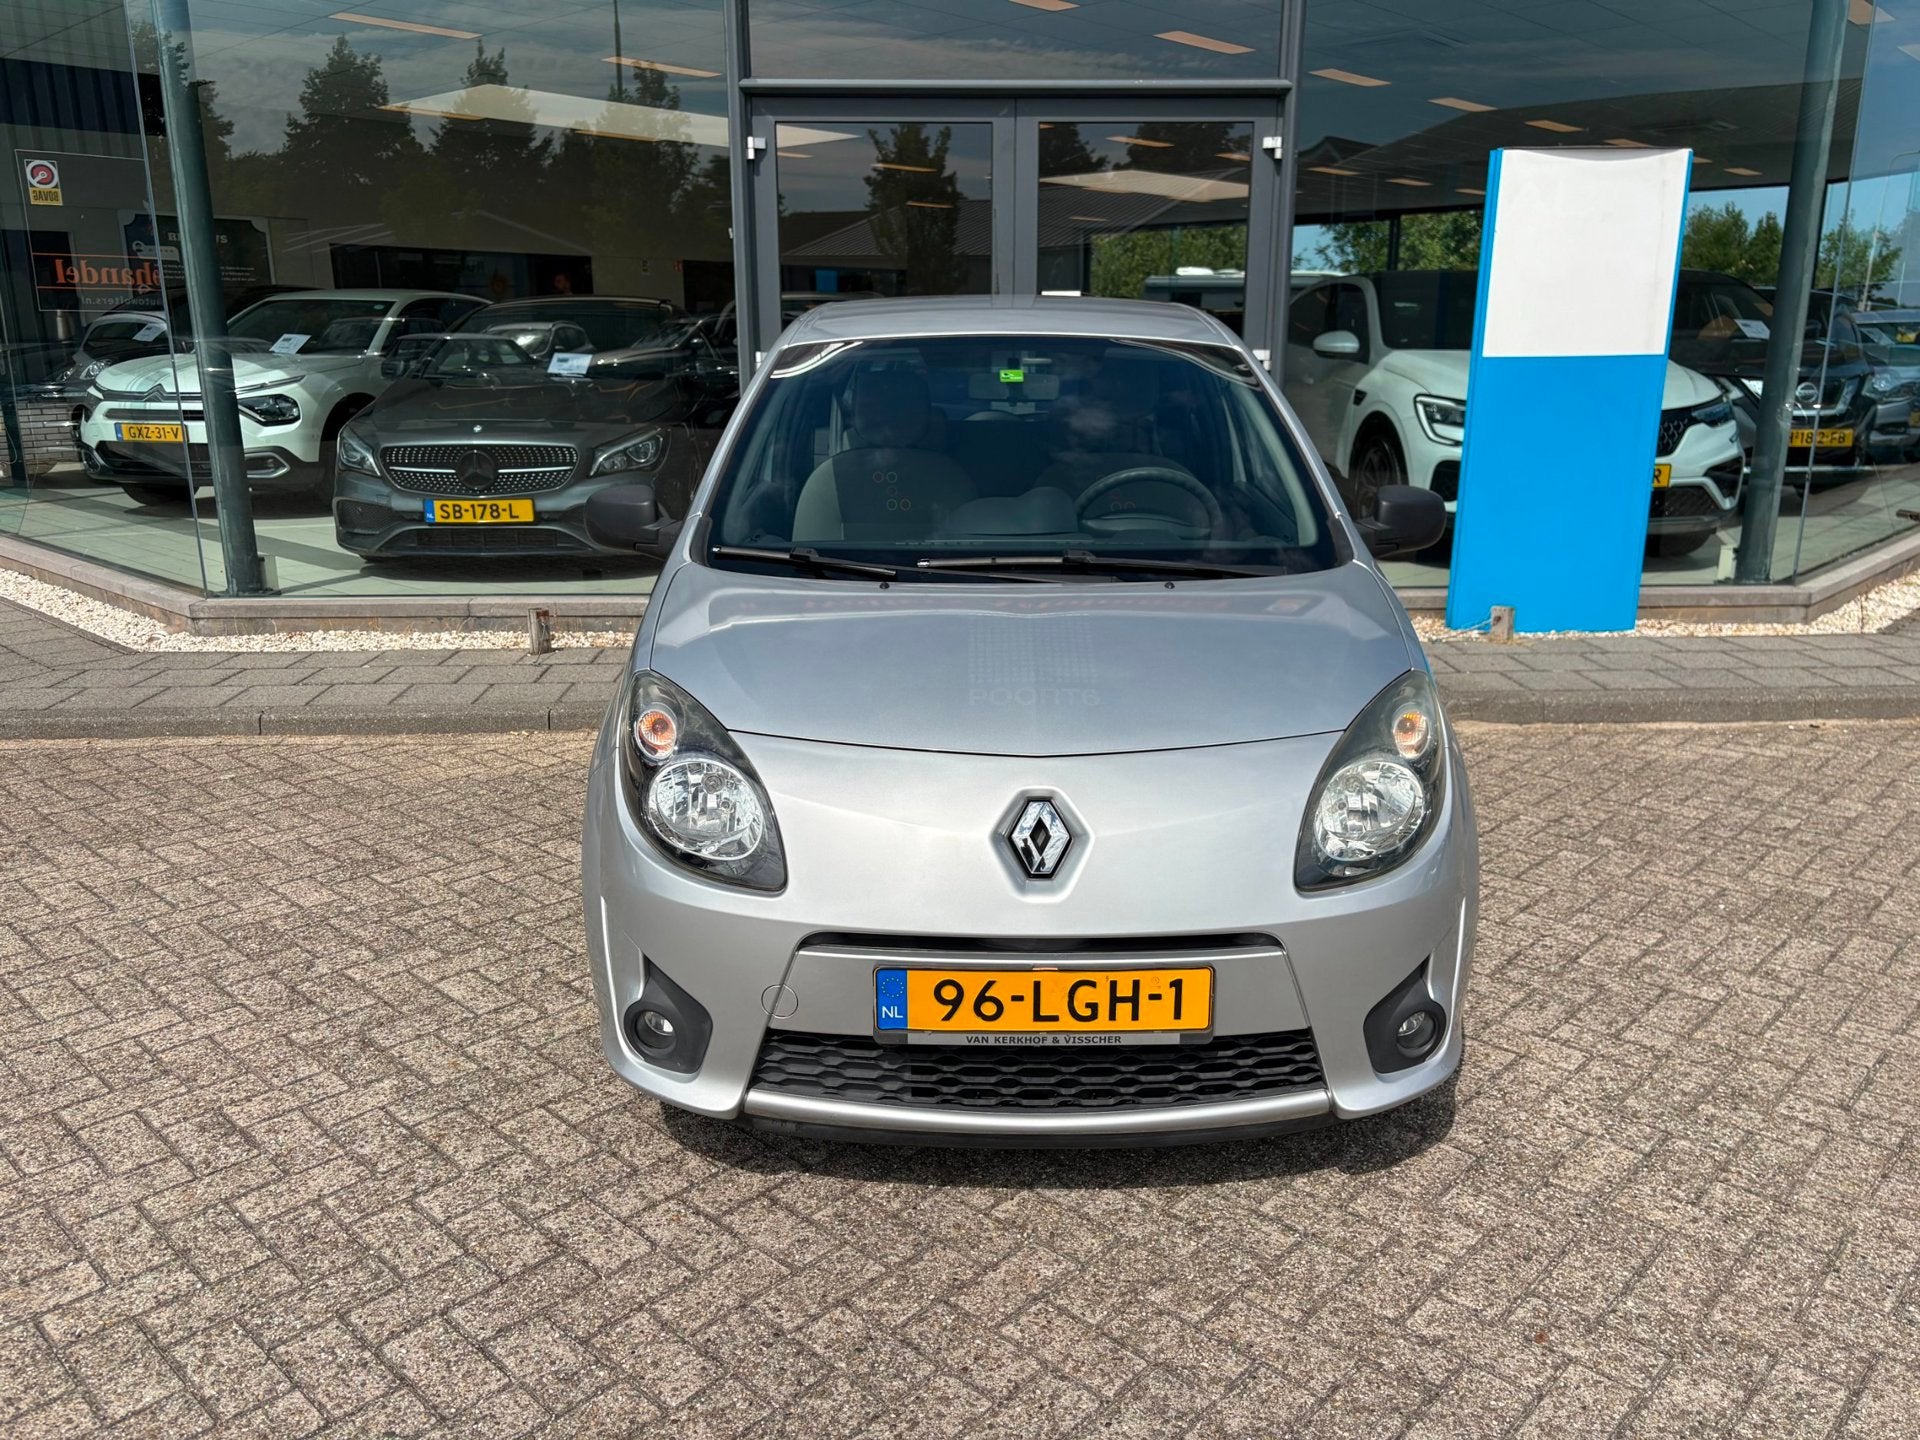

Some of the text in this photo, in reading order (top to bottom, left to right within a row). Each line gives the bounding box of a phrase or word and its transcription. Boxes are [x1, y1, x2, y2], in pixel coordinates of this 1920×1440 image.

[128, 426, 179, 439] GXZ-31-V
[439, 503, 519, 519] SB-178-L
[933, 978, 1182, 1022] 96-LGH-1
[882, 1007, 903, 1018] NL
[966, 1035, 1121, 1044] VAN KERKHOF & VISSCHER
